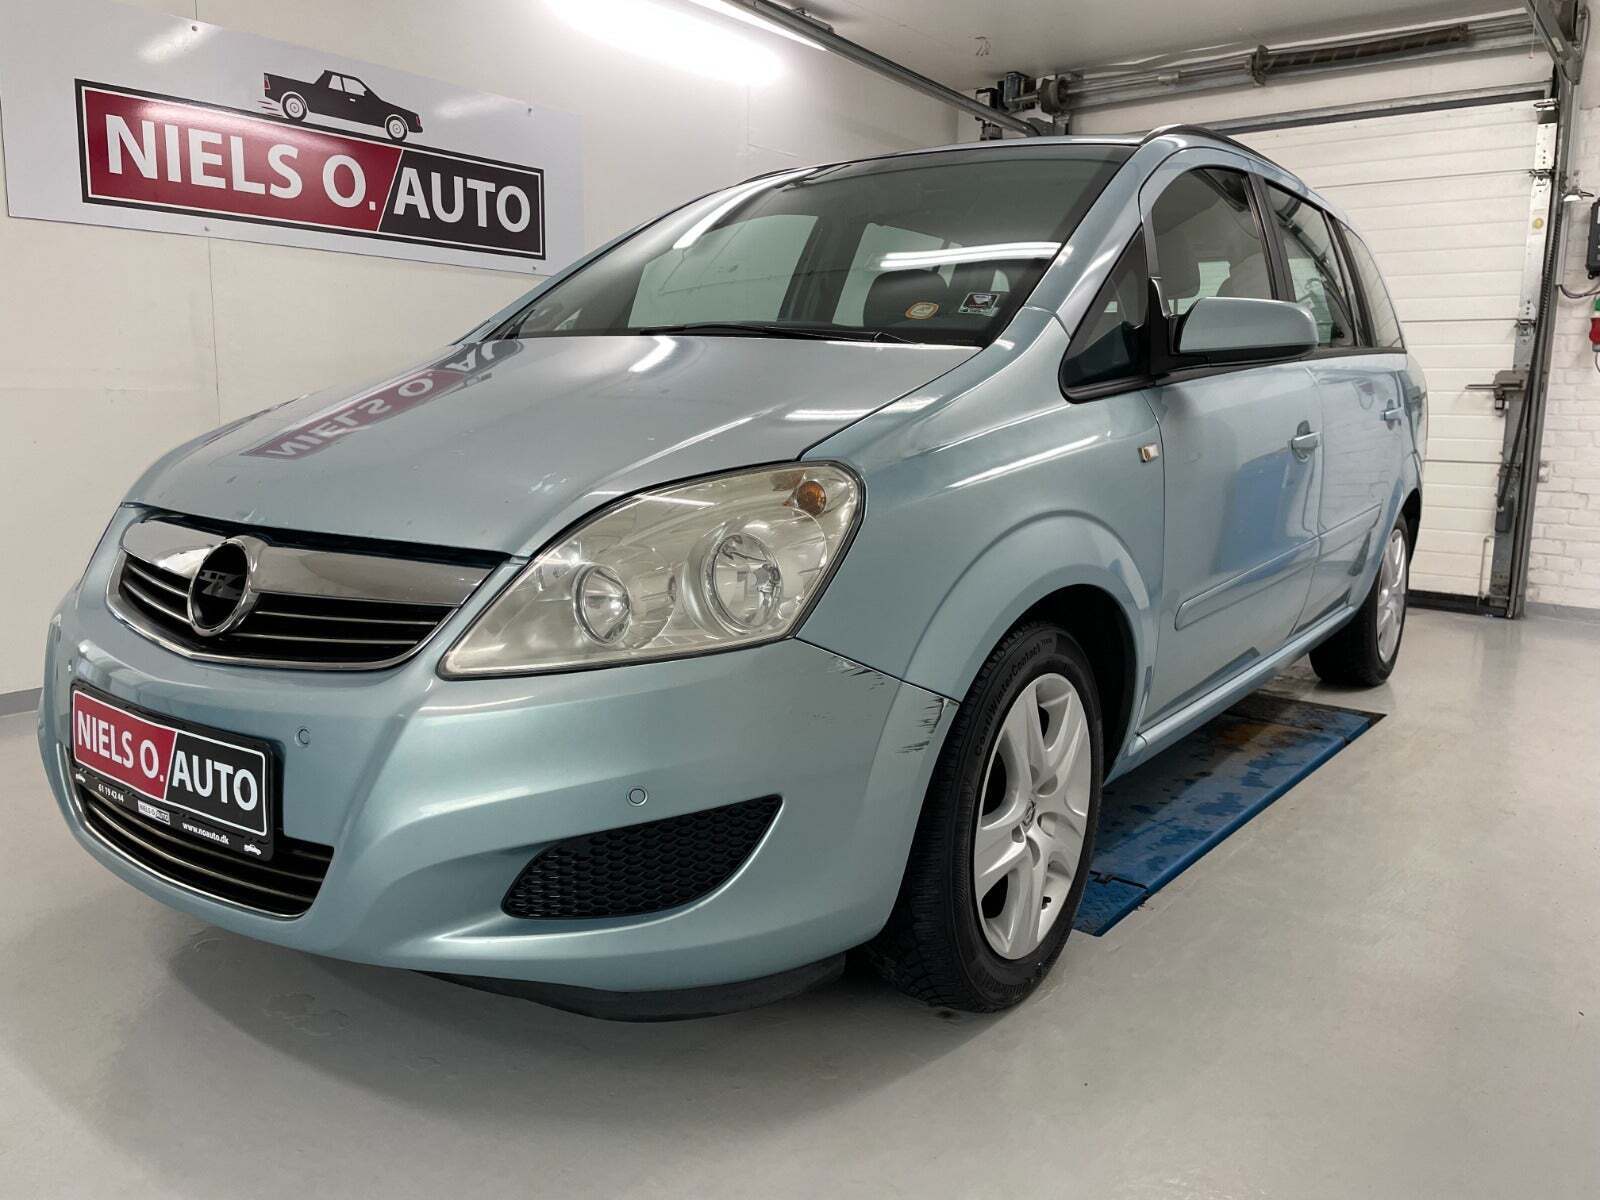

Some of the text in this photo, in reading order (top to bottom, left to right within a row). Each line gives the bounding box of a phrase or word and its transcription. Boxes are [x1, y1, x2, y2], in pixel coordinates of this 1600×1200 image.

[105, 115, 531, 233] NIELS O. AUTO
[77, 710, 258, 811] NIELS O. AUTO
[182, 822, 229, 845] www.noauto.dk
